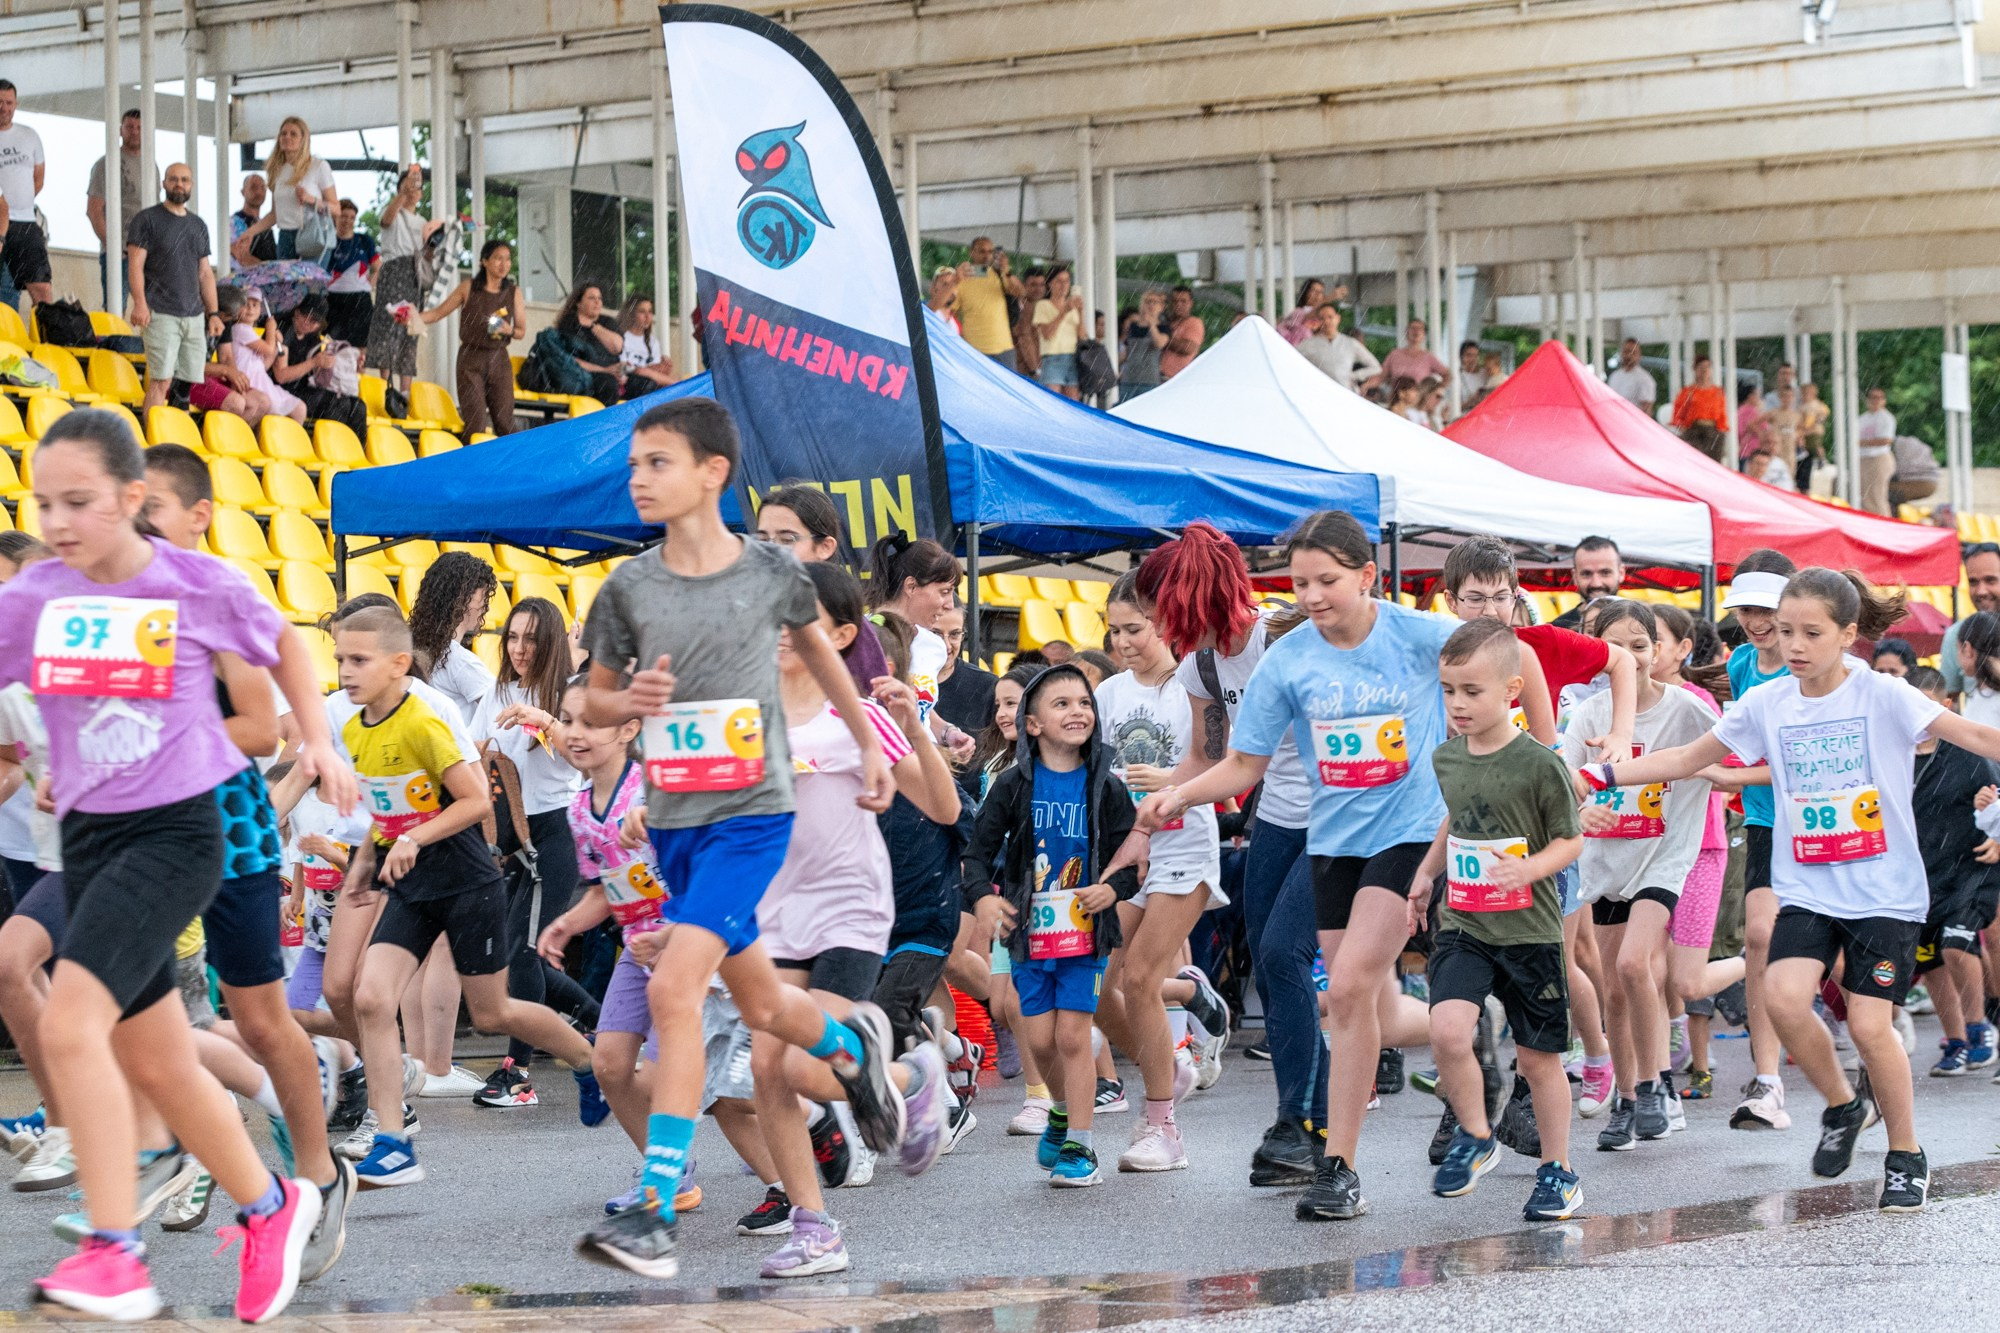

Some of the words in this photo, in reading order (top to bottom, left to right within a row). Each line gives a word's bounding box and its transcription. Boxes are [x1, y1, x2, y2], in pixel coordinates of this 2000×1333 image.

[65, 616, 111, 649] 97
[665, 721, 705, 751] 16
[1326, 733, 1362, 756] 99
[1788, 754, 1864, 778] TRIATHLON
[371, 790, 392, 811] 15
[1803, 806, 1837, 830] 98
[1455, 854, 1480, 879] 10
[1033, 905, 1056, 928] 39
